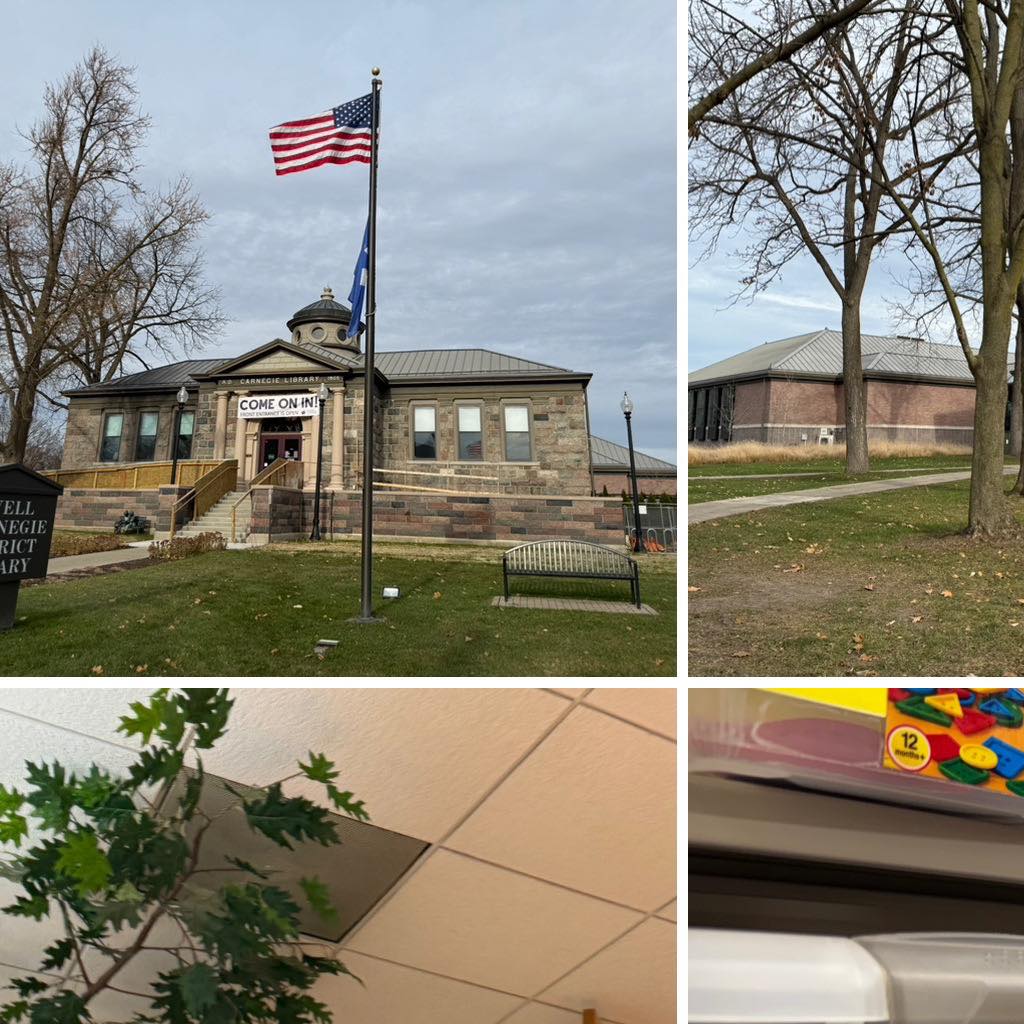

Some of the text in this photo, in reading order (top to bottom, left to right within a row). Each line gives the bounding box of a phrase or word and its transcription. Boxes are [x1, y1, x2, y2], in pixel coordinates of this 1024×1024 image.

[239, 395, 318, 411] COME ON IN!
[0, 500, 35, 516] ELL
[900, 731, 919, 751] 12
